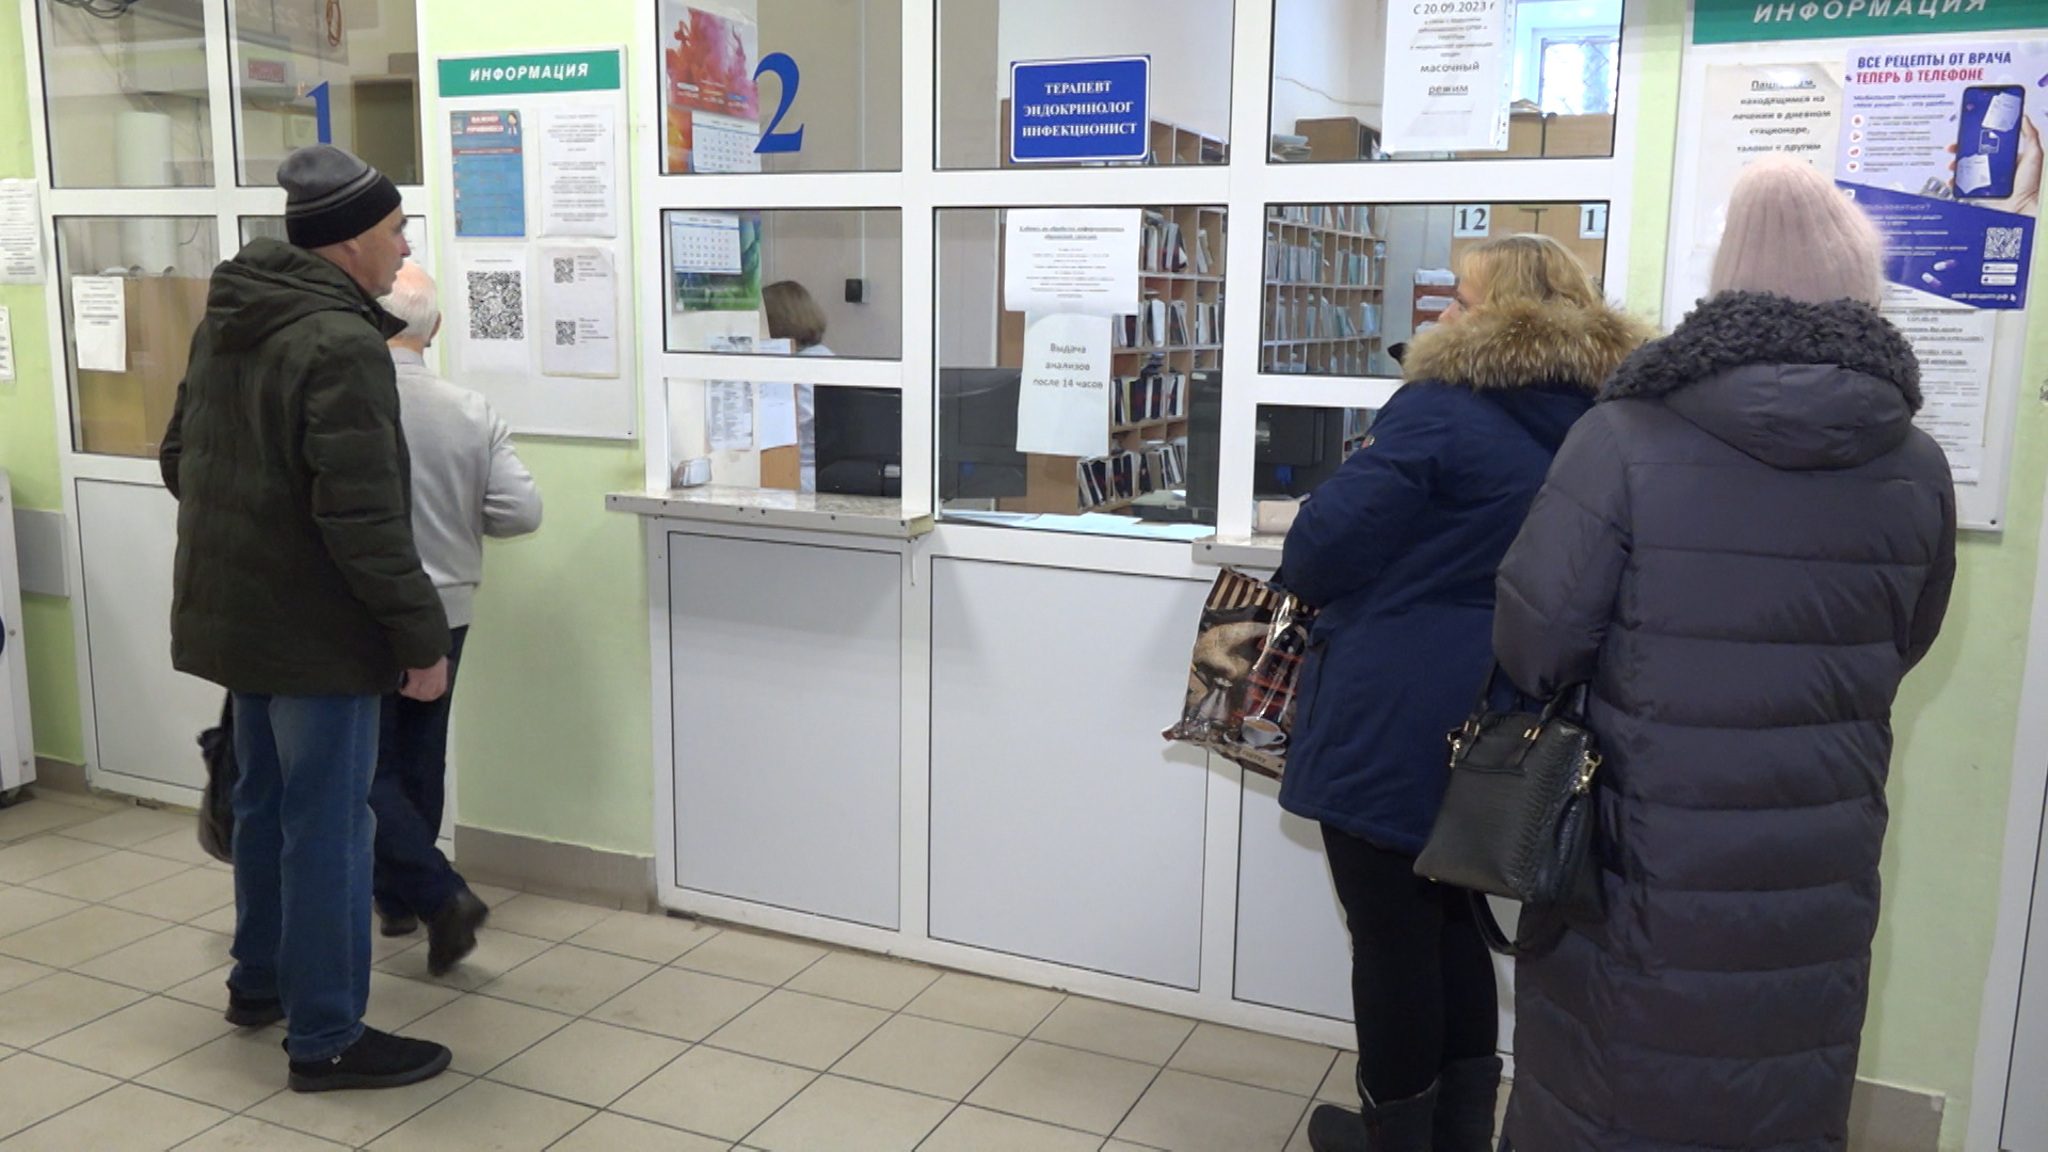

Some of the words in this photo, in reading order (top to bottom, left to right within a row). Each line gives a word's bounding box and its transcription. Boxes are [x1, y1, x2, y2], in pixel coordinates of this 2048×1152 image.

[1753, 0, 1986, 23] ИНФОРМАЦИЯ
[1420, 61, 1480, 72] масочный
[1857, 56, 1880, 69] ВСЕ
[1885, 54, 1945, 69] РЕЦЕПТЫ
[1949, 53, 1965, 66] ОТ
[1968, 52, 2012, 65] ВРАЧА
[470, 63, 589, 81] ИНФОРМАЦИЯ
[1856, 71, 1900, 84] ТЕПЕРЬ
[1905, 71, 1913, 83] В
[1917, 68, 1985, 82] ТЕЛЕФОНЕ
[1044, 80, 1113, 95] ТЕРАПЕВТ
[1428, 85, 1468, 95] режим
[753, 52, 804, 153] 2
[1023, 101, 1134, 118] ЭНДОКРИНОЛОГ
[305, 81, 332, 144] 1
[1022, 121, 1138, 138] ИНФЕКЦИОНИСТ
[1458, 207, 1487, 231] 12
[1050, 343, 1087, 354] Выдача
[1045, 362, 1091, 371] анализов
[1033, 379, 1060, 388] после
[1062, 379, 1074, 388] 14
[1076, 381, 1104, 390] часов
